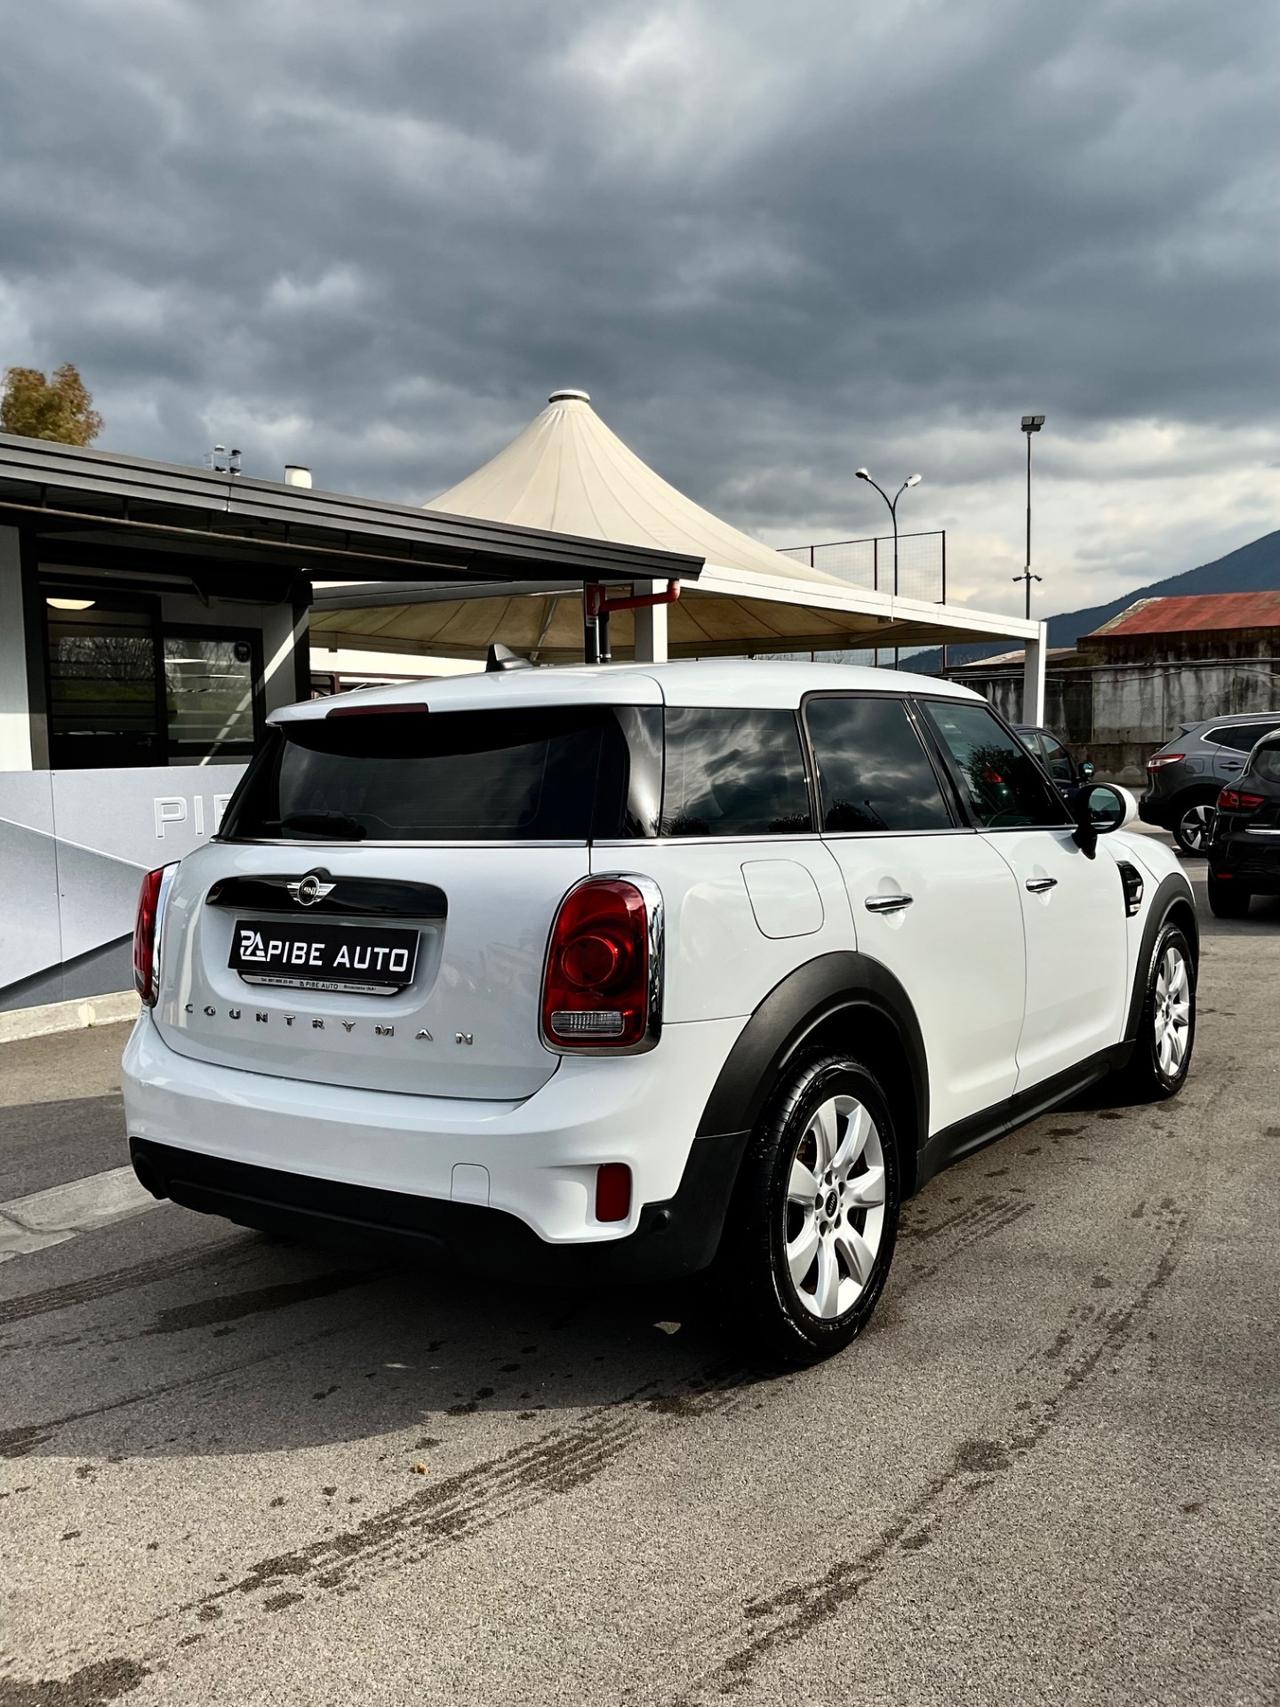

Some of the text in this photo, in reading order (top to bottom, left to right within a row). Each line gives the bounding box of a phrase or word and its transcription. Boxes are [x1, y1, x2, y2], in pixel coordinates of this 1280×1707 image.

[266, 940, 326, 966] PIBE
[333, 945, 409, 972] AUTO
[184, 1003, 474, 1045] COUNTRYMAN
